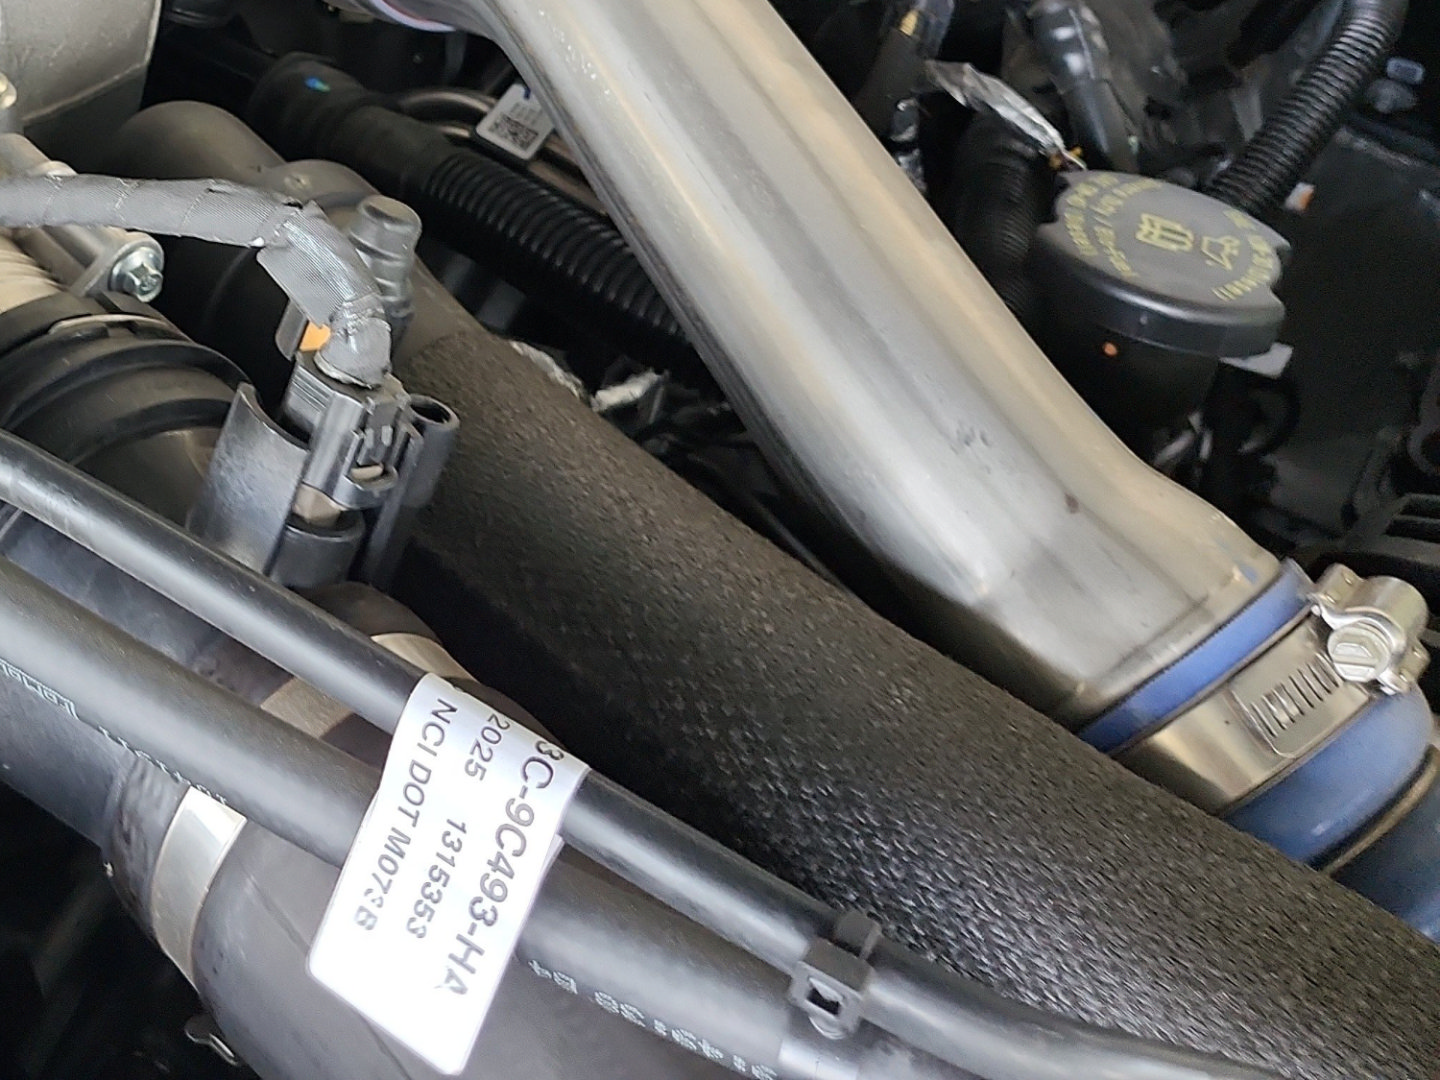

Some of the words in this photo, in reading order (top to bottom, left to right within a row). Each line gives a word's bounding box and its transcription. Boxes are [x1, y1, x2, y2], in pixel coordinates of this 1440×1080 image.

[417, 698, 458, 757] NCI
[464, 712, 511, 781] 2025
[398, 759, 433, 828] DOT
[356, 826, 412, 931] M073B
[406, 818, 467, 939] 1315353
